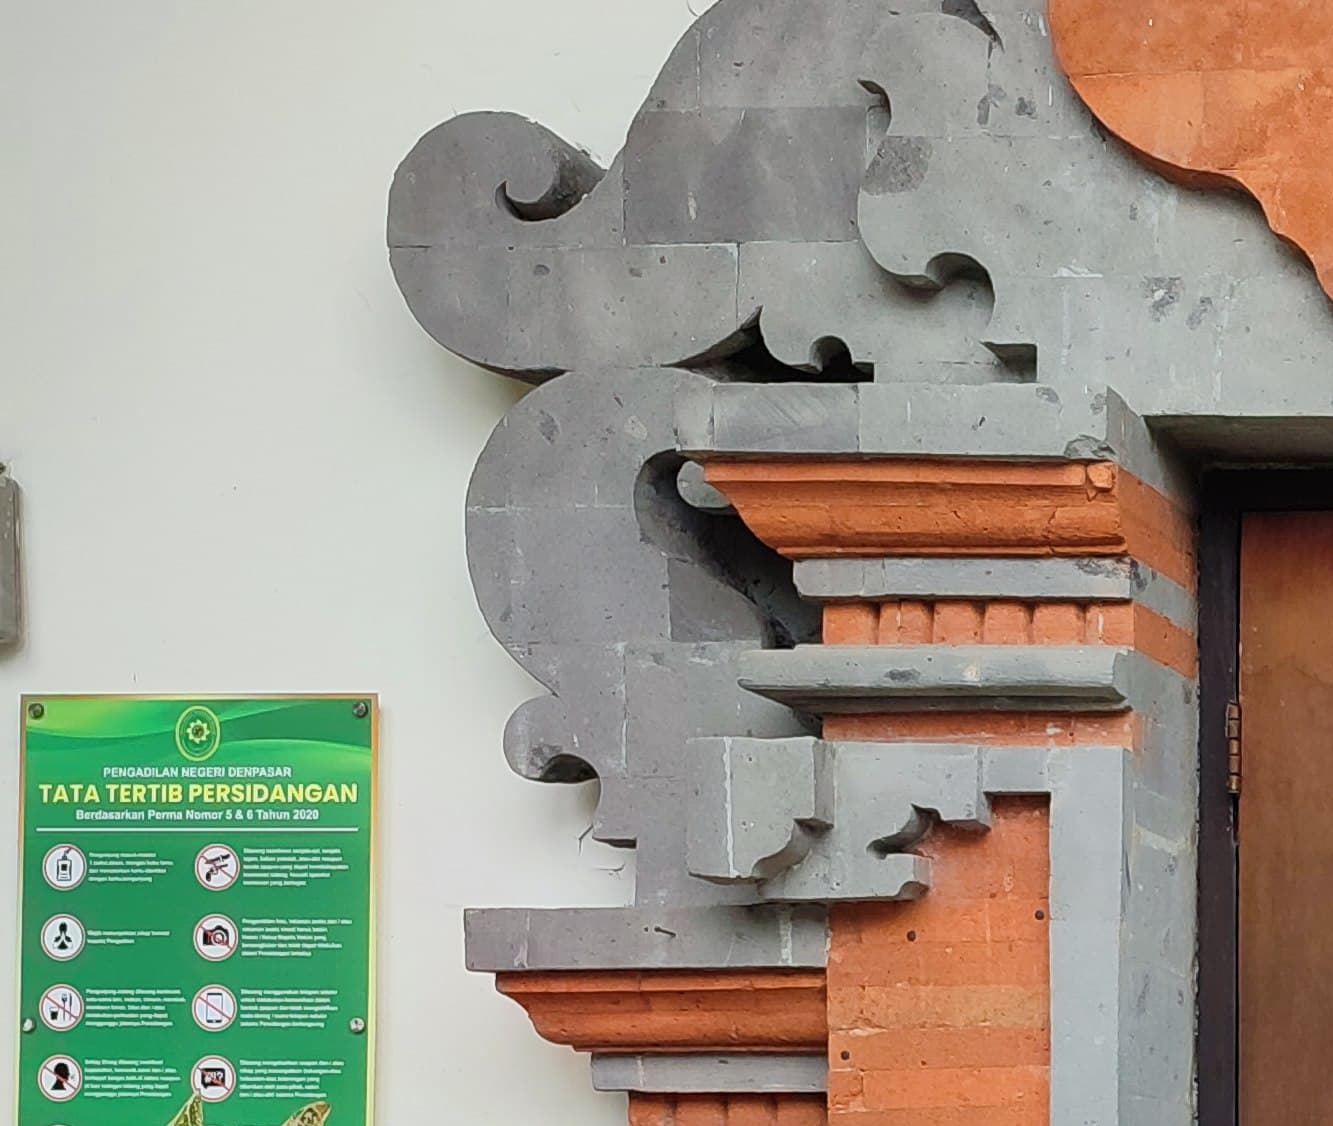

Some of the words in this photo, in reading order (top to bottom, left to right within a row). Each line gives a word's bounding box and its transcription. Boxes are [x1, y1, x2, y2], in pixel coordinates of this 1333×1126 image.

[104, 767, 178, 778] PENGADILAN
[182, 767, 225, 778] NEGERI
[228, 766, 292, 778] DENPASAR
[38, 783, 101, 803] TATA
[105, 783, 183, 803] TERTIB
[188, 783, 358, 803] PERSIDANGAN
[76, 809, 144, 821] Berdasarkan
[147, 809, 182, 821] Perma
[186, 809, 223, 821] Nomor
[225, 809, 233, 820] 5
[234, 809, 244, 820] &
[257, 809, 290, 820] Tahun
[293, 809, 319, 820] 2020
